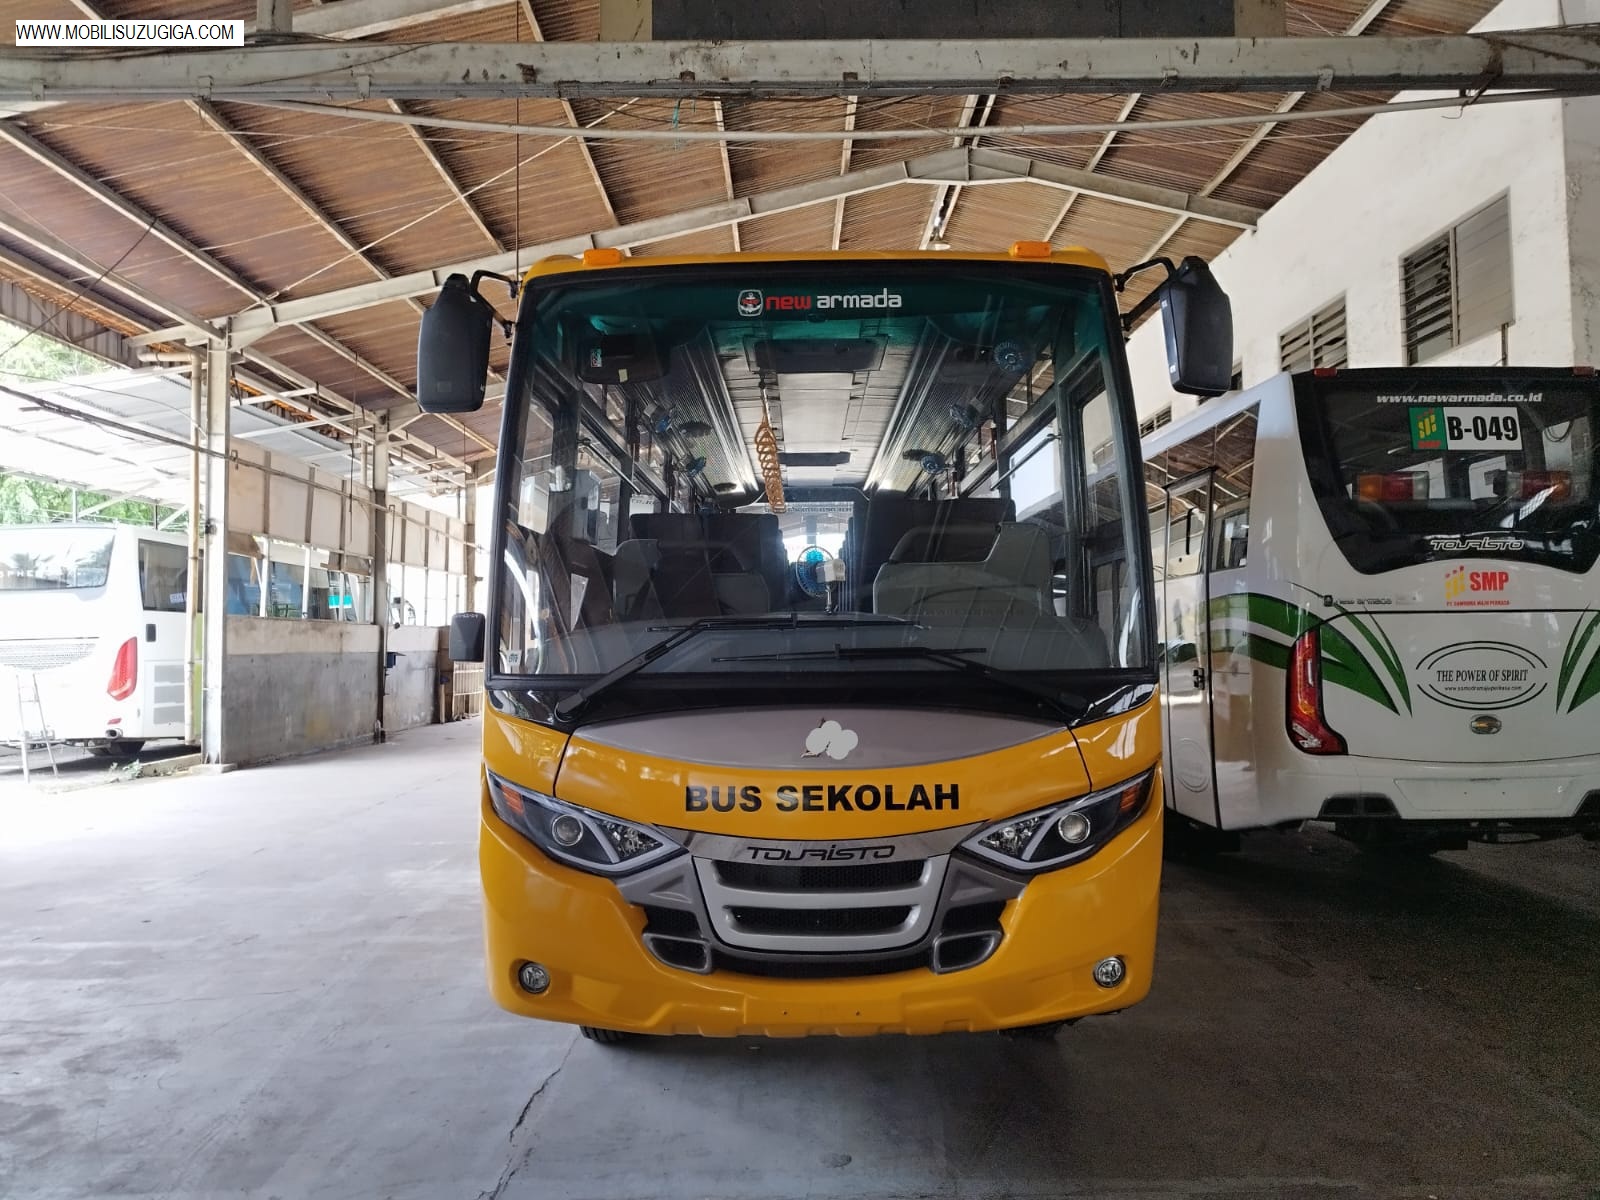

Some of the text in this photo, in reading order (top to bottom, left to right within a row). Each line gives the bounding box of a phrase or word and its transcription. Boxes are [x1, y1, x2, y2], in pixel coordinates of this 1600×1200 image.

[765, 287, 903, 310] new armada
[1376, 392, 1543, 404] www.newarmada.co.id
[1447, 415, 1519, 442] B-049
[1469, 571, 1510, 592] SMP
[1436, 669, 1529, 682] THE POWER OF SPIRIT
[685, 783, 960, 813] BUS SEKOLAH
